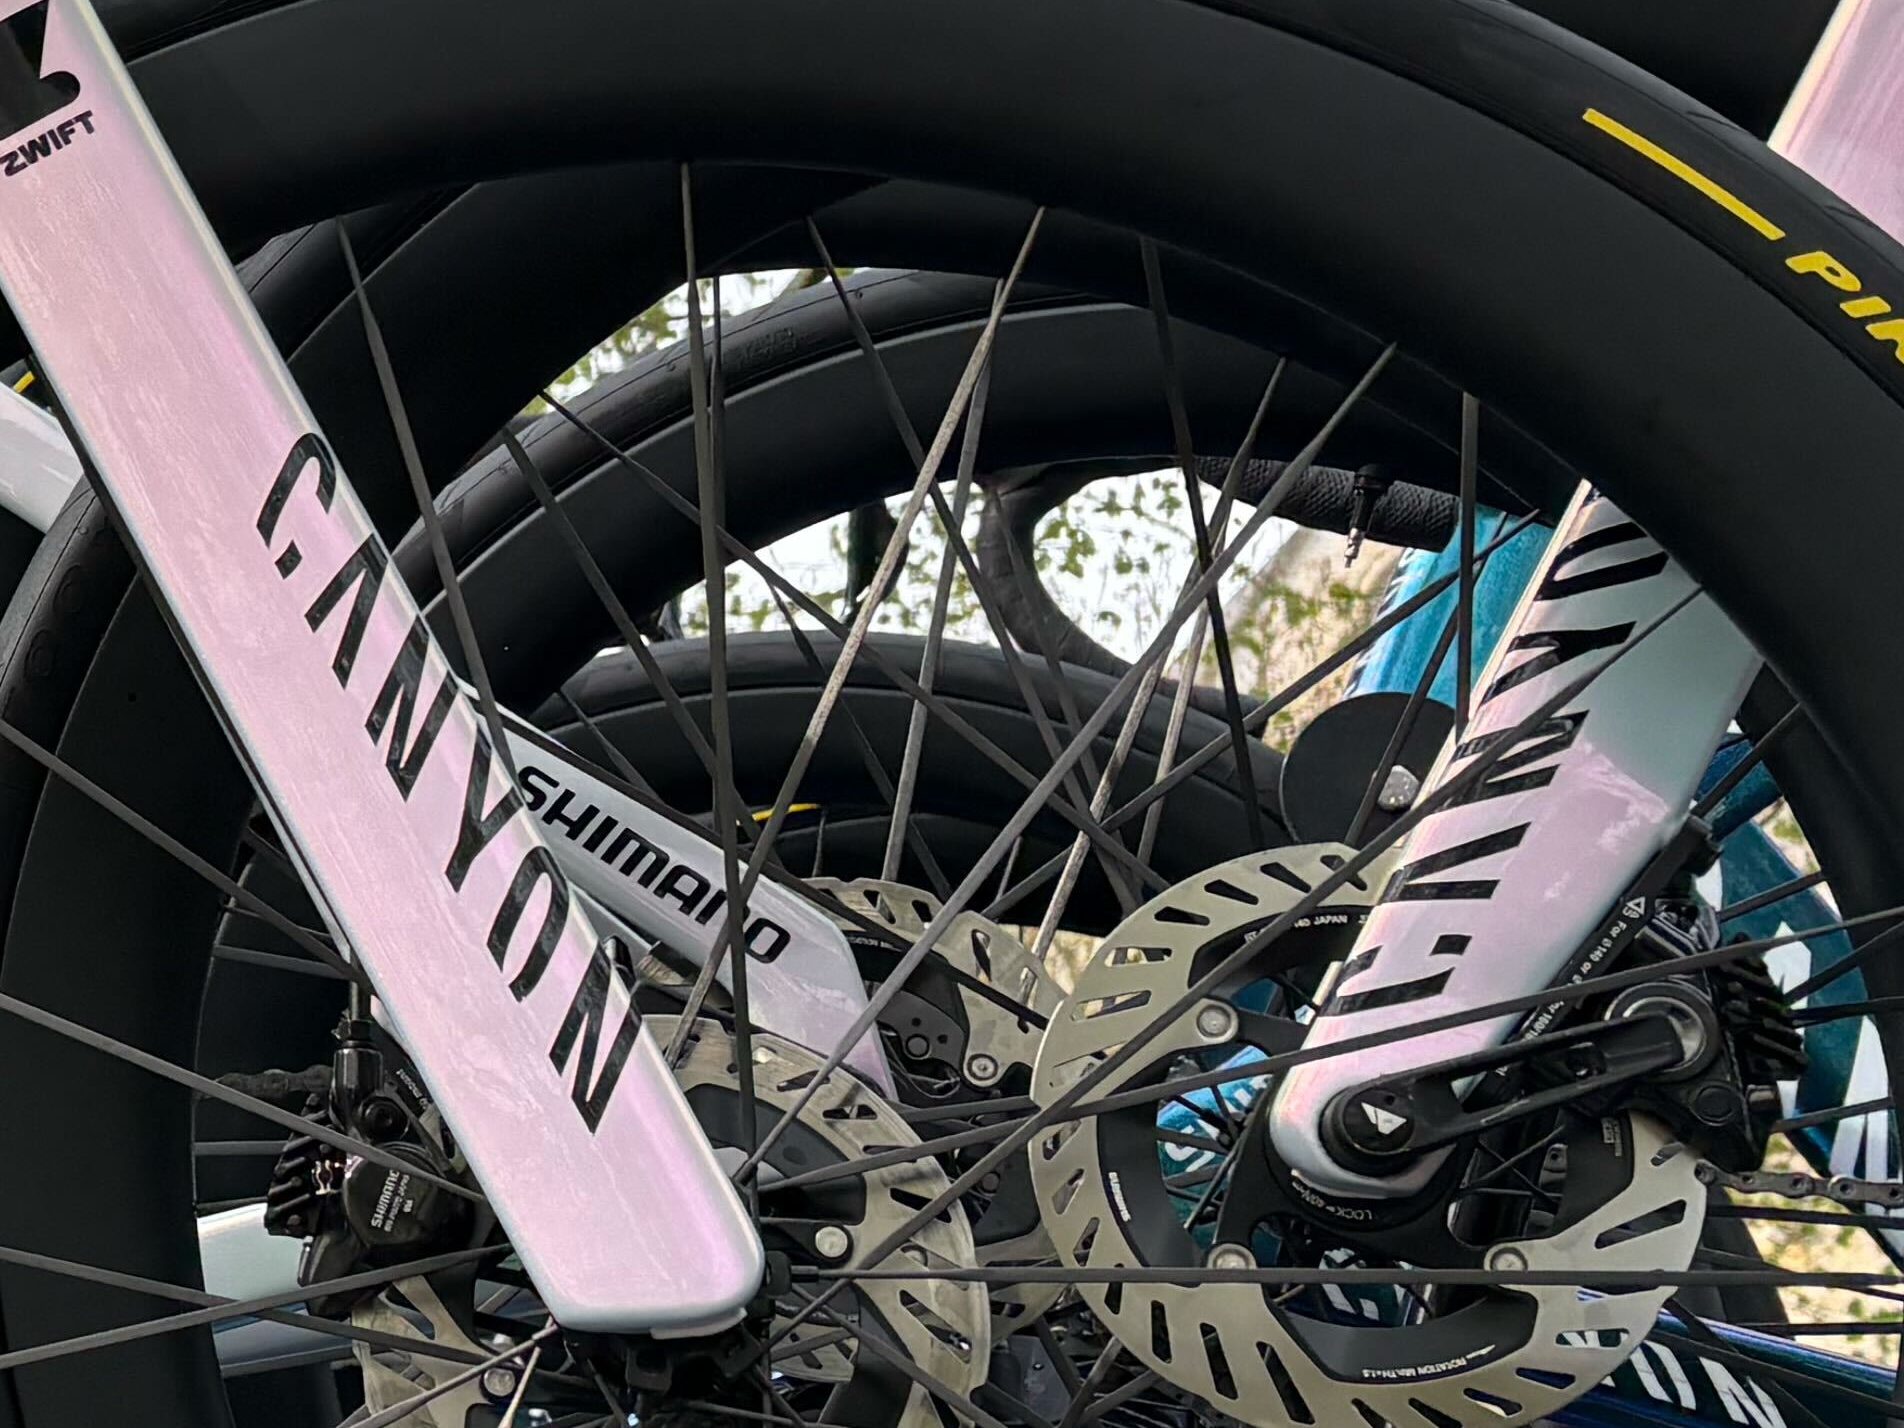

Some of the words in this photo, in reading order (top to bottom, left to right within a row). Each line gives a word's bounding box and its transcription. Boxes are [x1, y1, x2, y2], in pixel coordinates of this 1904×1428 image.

[255, 431, 644, 1137] CANYON
[1313, 914, 1349, 927] JAPAN
[1608, 920, 1628, 938] For
[1579, 961, 1592, 974] or
